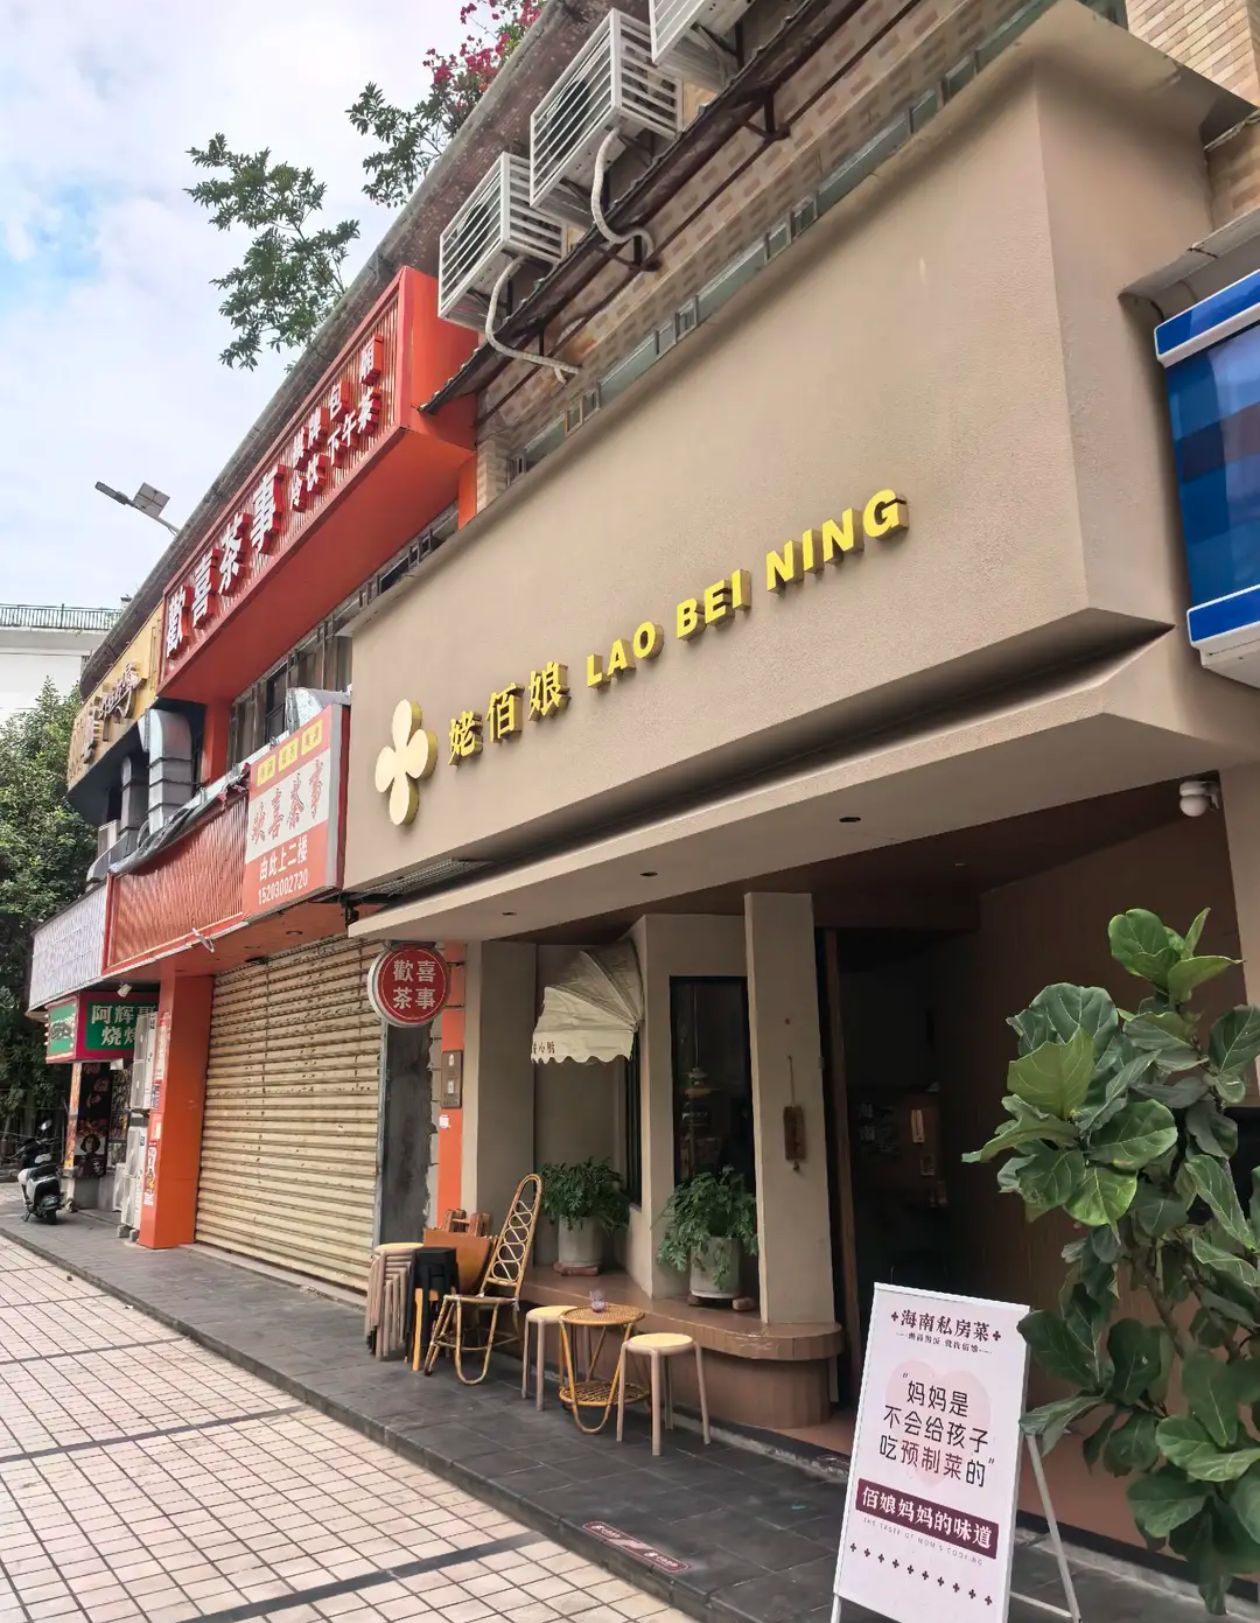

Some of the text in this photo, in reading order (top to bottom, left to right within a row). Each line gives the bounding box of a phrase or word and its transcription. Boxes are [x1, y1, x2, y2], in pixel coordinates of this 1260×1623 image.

[587, 488, 905, 687] LAO BEI NING
[448, 660, 565, 765] 姥佰娘
[258, 835, 309, 881] 由此上二楼
[257, 868, 309, 905] 15203002720
[393, 959, 437, 983] 歡喜
[393, 986, 437, 1010] 茶事
[900, 1309, 990, 1342] 海南私房菜
[883, 1405, 989, 1453] 不会给孩子
[861, 1486, 993, 1549] 佰娘妈妈的味道
